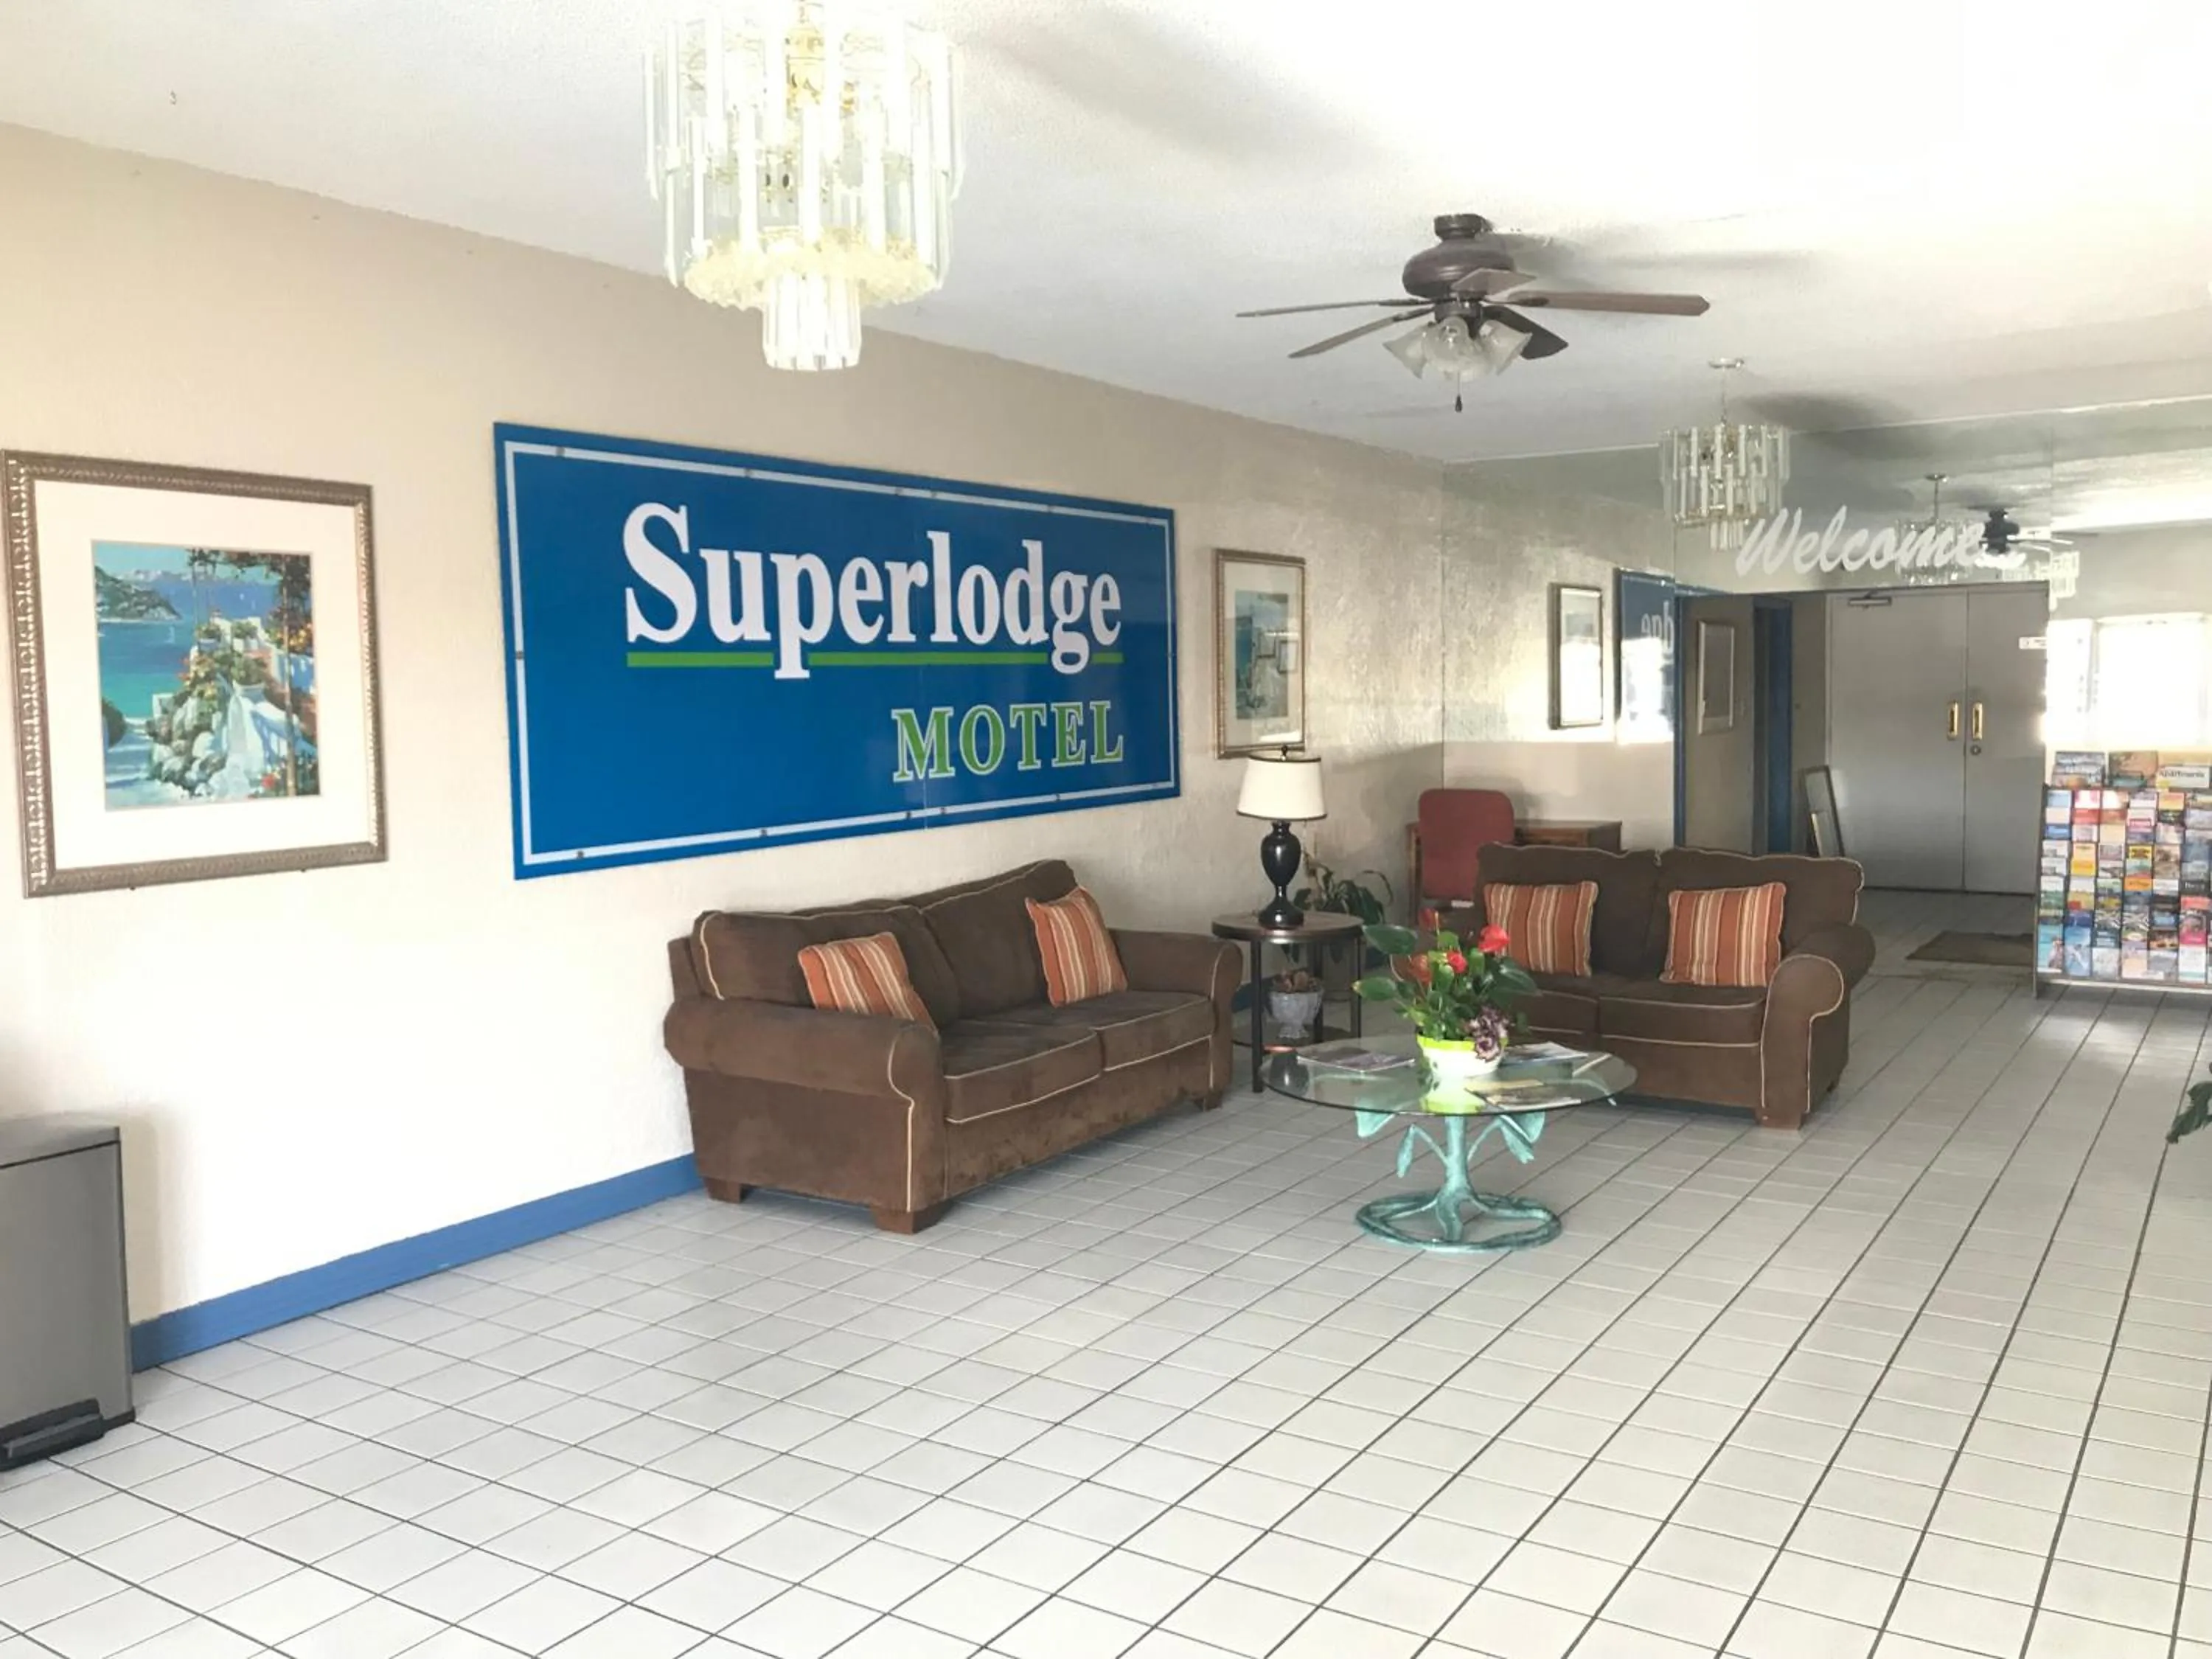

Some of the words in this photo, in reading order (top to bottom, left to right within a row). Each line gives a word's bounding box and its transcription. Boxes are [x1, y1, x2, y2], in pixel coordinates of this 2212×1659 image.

[1735, 504, 1986, 576] Welcome
[623, 502, 1121, 678] Superlodge
[891, 700, 1124, 782] MOTEL
